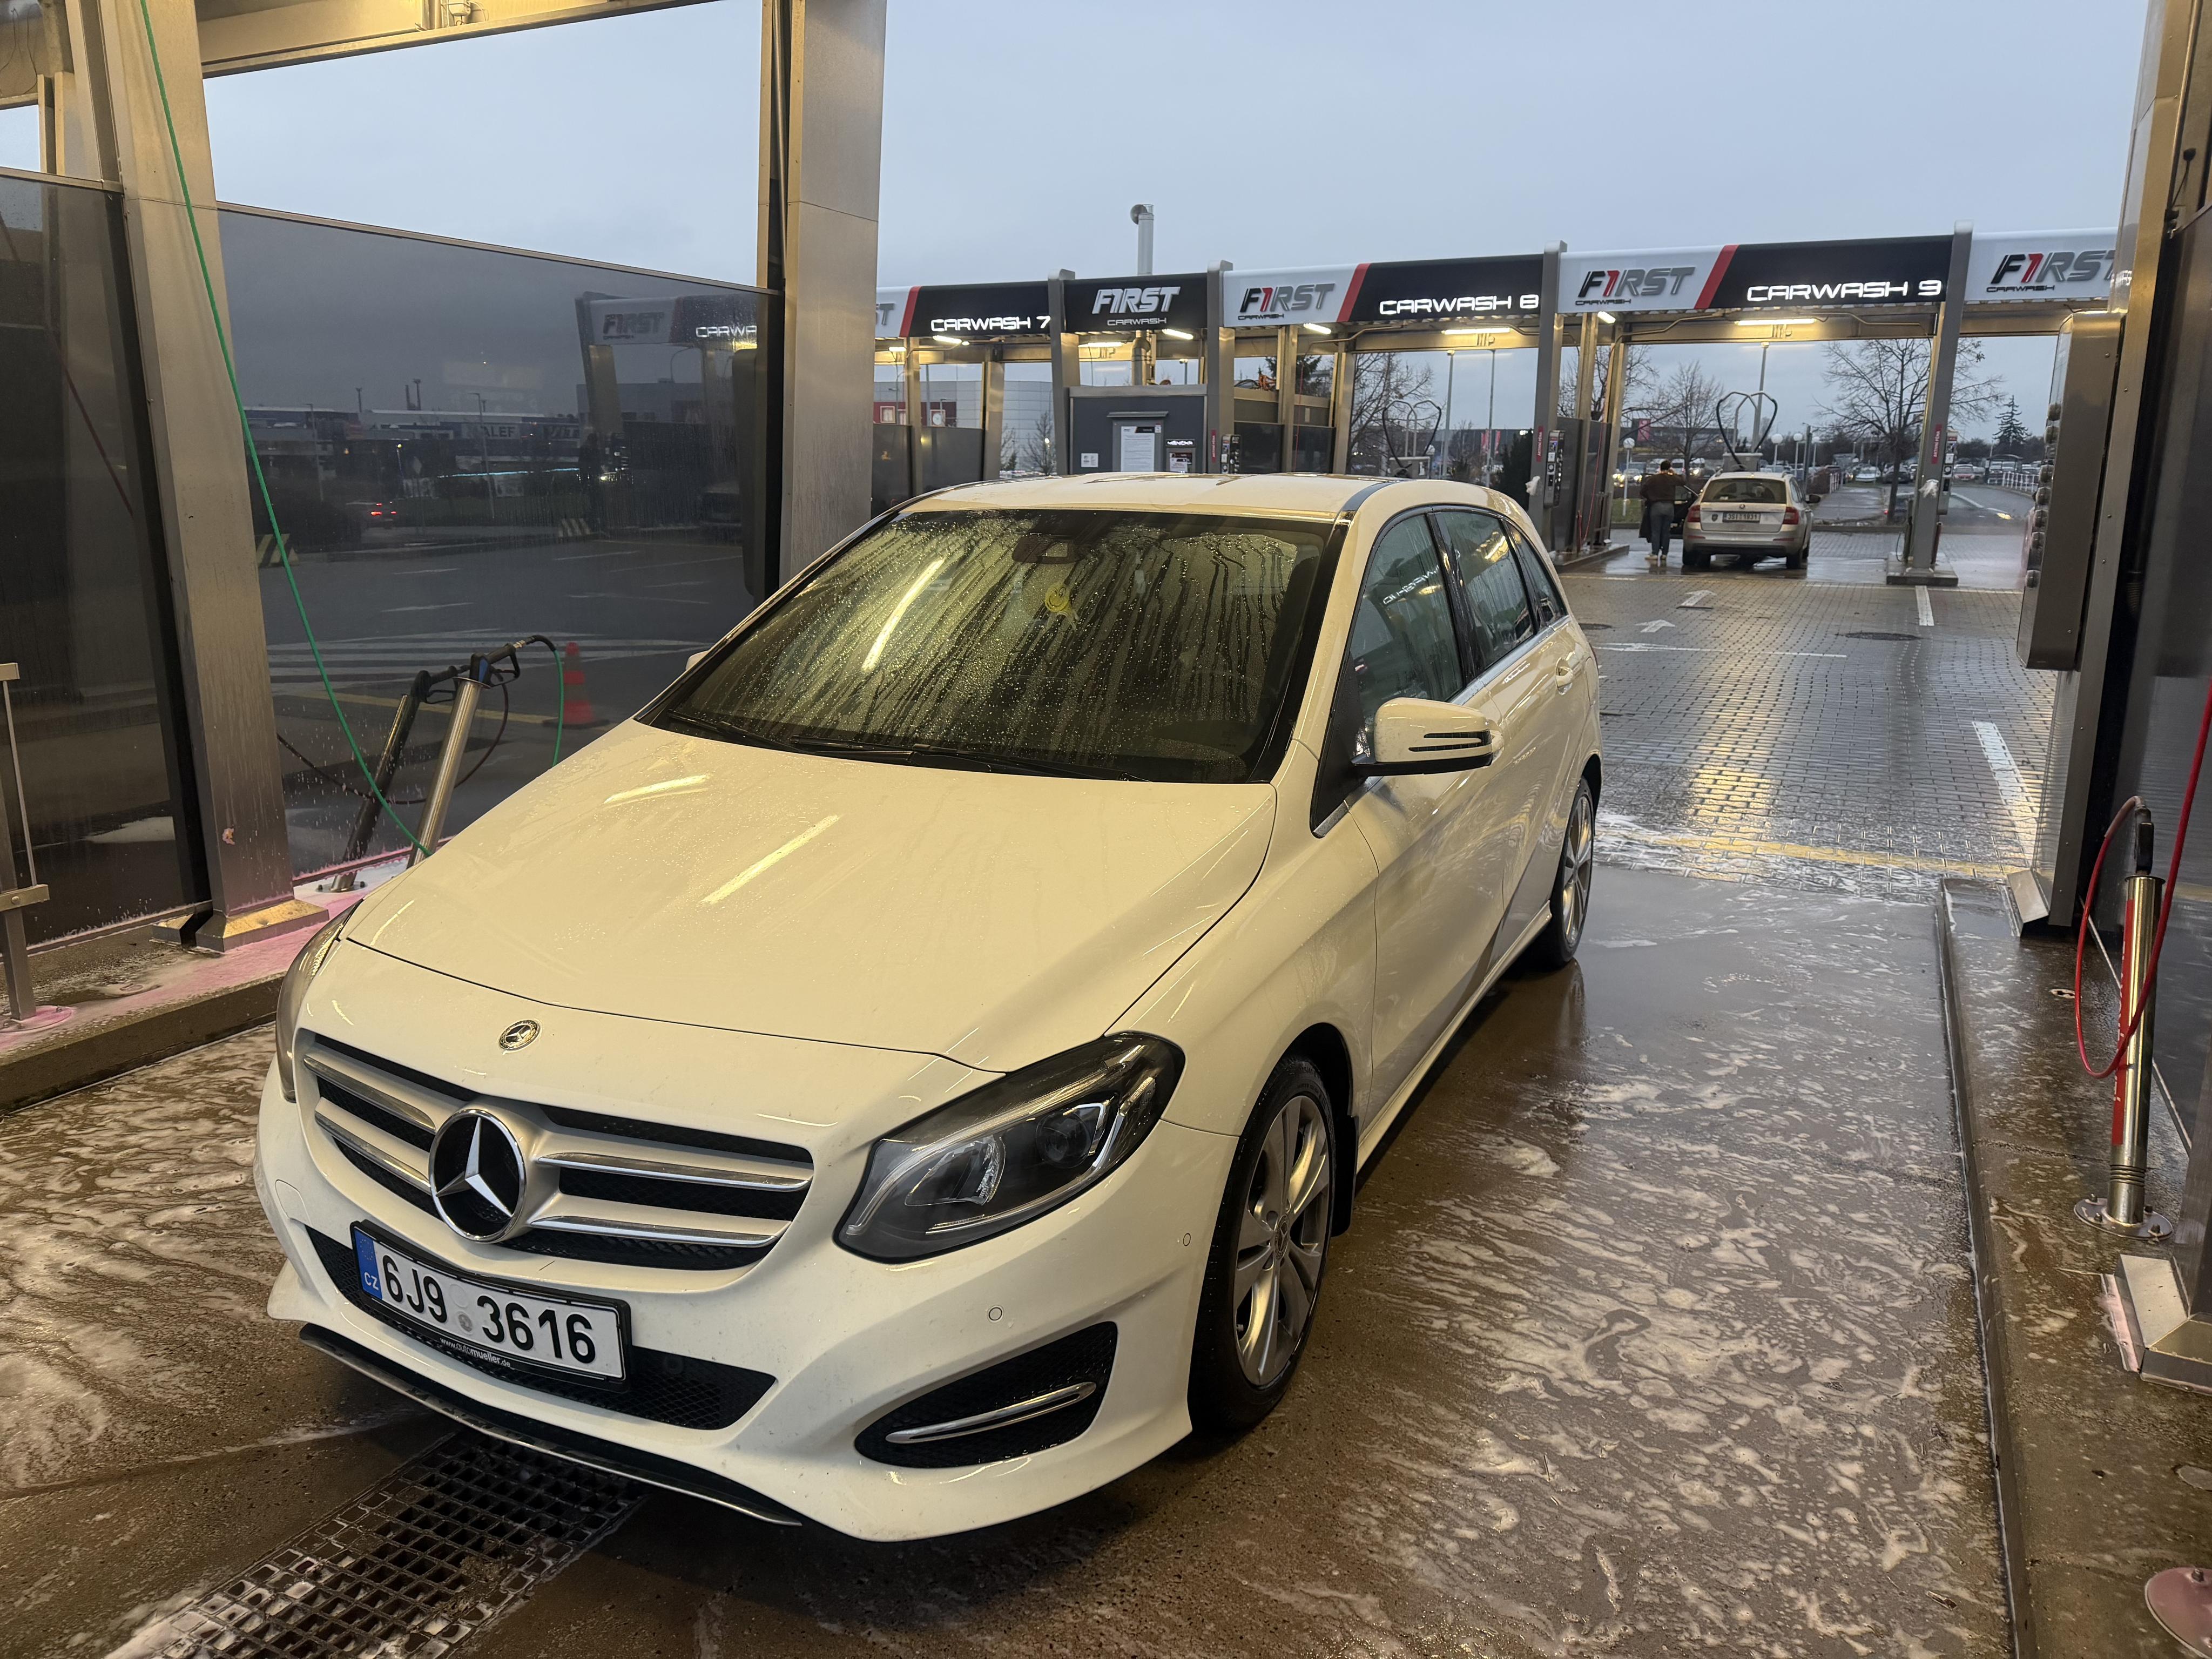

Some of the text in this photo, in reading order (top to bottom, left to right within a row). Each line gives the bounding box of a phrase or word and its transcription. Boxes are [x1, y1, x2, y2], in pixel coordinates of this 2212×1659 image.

[1747, 279, 1942, 302] CARWASH 9
[1986, 285, 2055, 293] CARWASH
[1379, 294, 1539, 315] CARWASH 8
[930, 315, 1051, 332] CARWASH 7
[1107, 318, 1167, 326] CARWASH
[364, 1255, 596, 1364] CZ 6J9 3616
[440, 1337, 511, 1367] www.automueller.de
